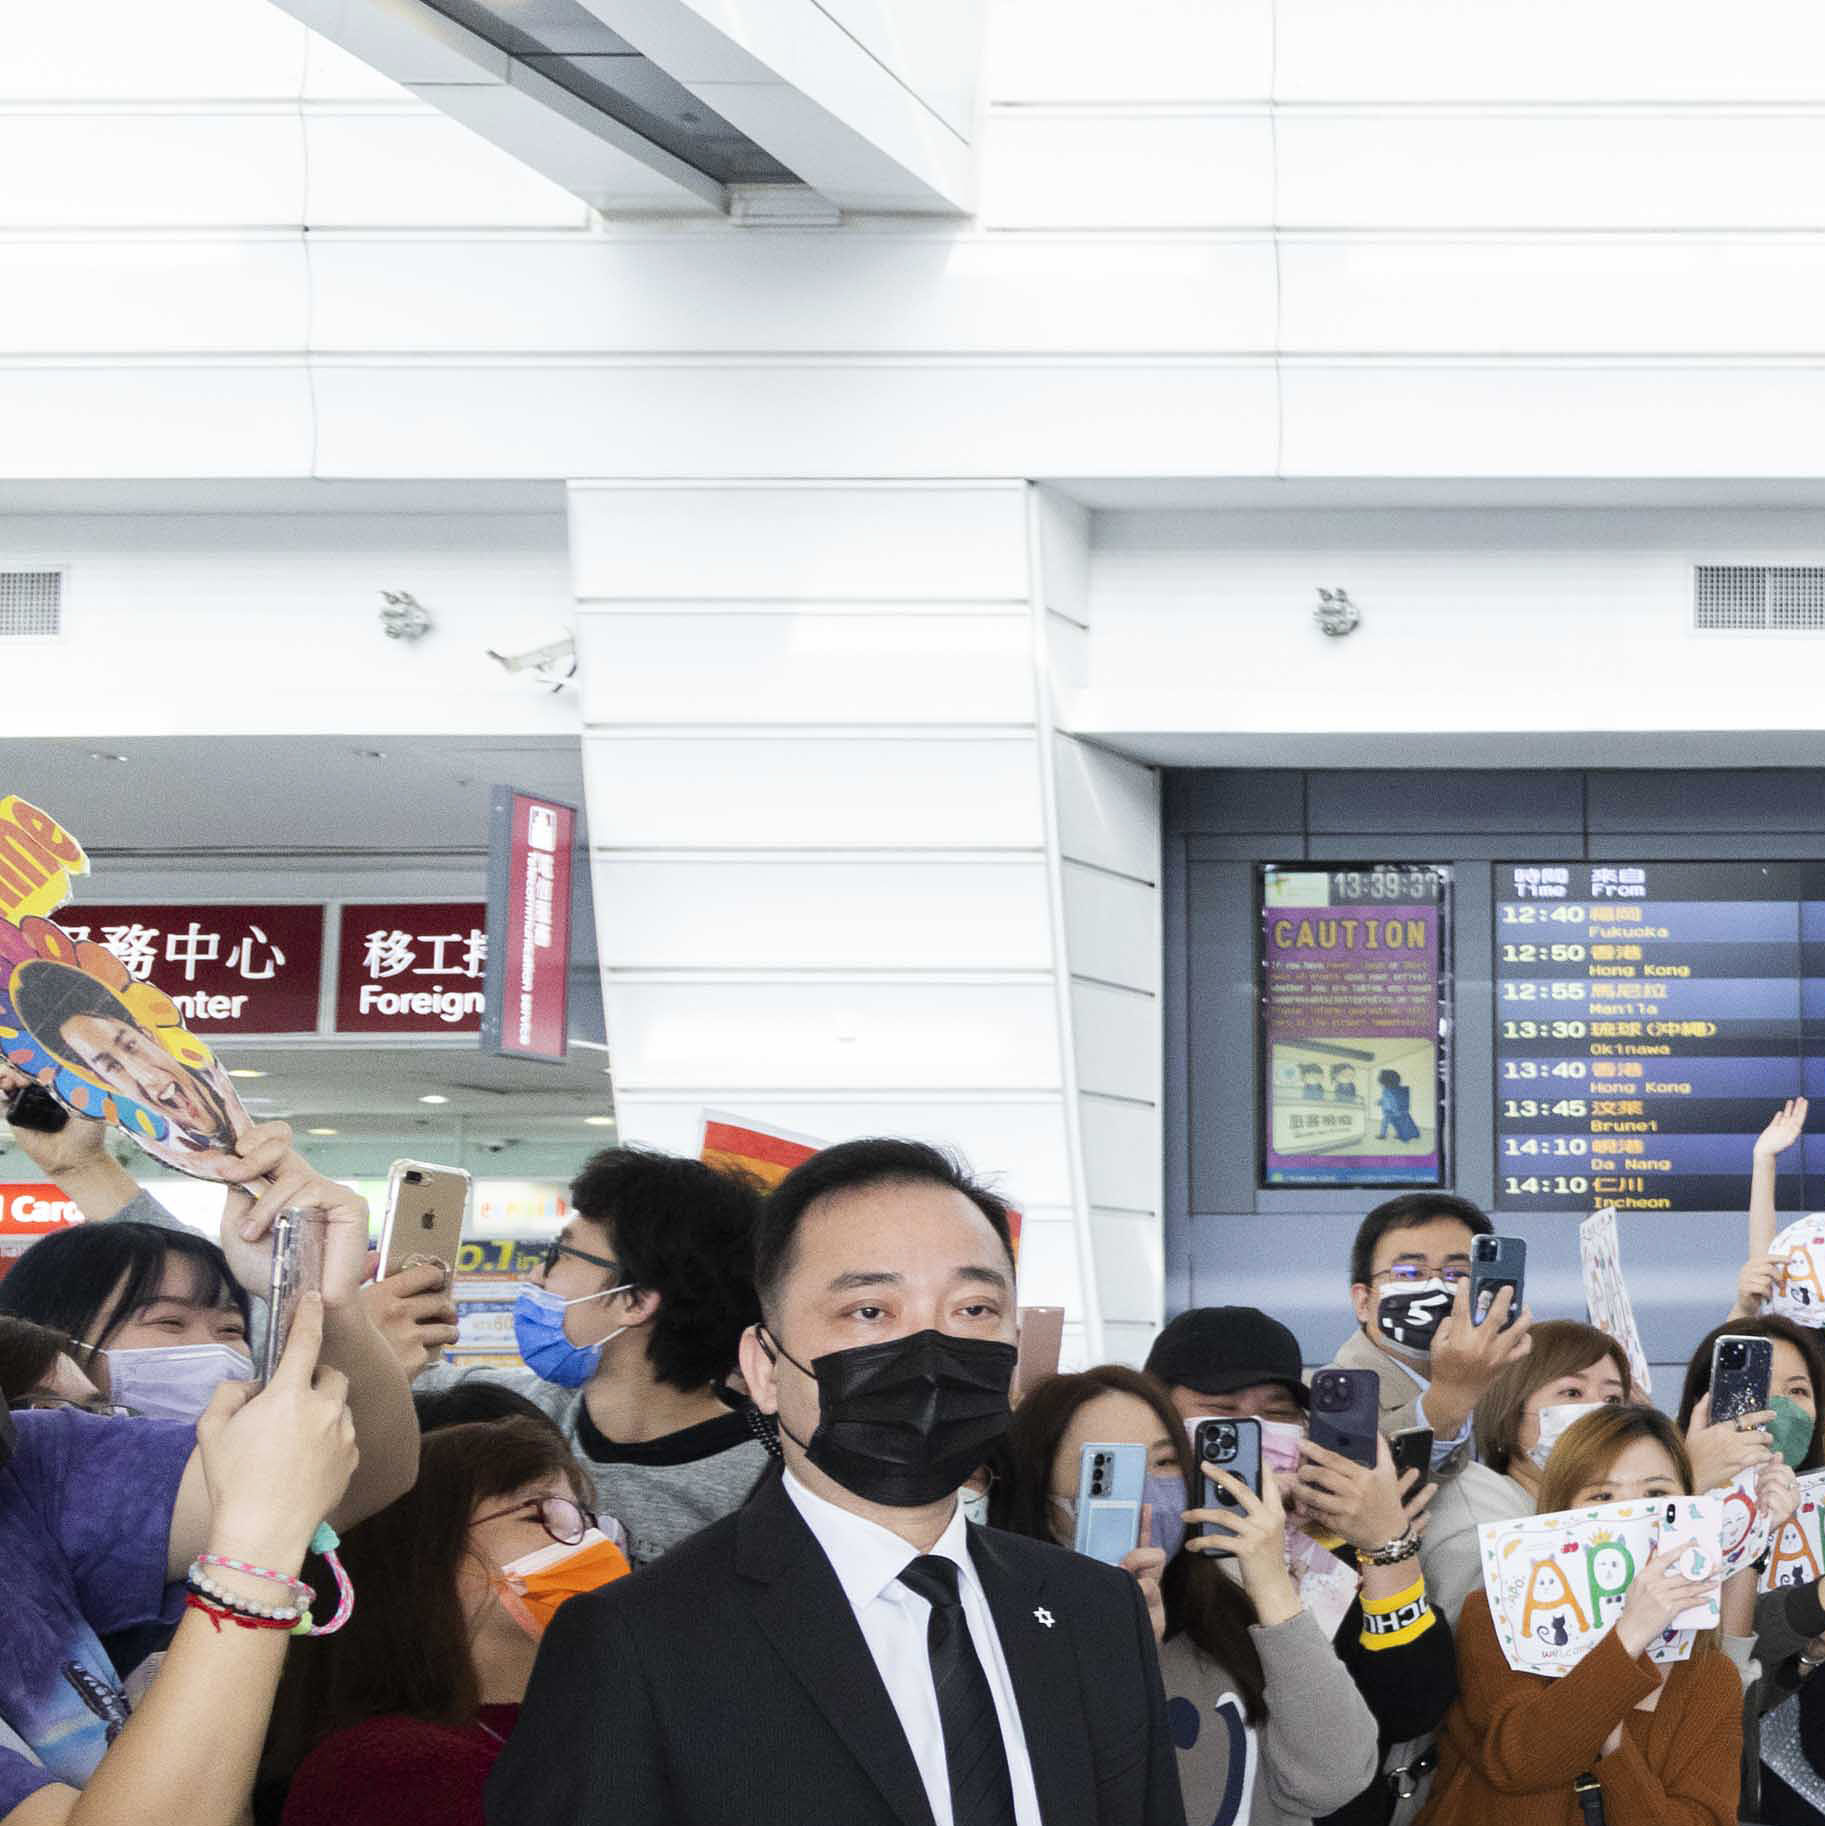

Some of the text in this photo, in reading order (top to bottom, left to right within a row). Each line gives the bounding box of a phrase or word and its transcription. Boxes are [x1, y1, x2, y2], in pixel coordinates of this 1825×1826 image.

[1514, 884, 1566, 896] Time
[1592, 884, 1646, 896] From
[1503, 906, 1583, 923] 12:40
[1274, 919, 1426, 949] CAUTION
[1589, 926, 1668, 938] Fukuoka
[1503, 945, 1584, 961] 12:50
[1589, 965, 1690, 977] Hong Kong
[1503, 984, 1584, 999] 12:55
[359, 984, 486, 1023] Foreign
[1589, 1003, 1658, 1015] Manila
[1503, 1022, 1586, 1038] 13:30
[1591, 1043, 1670, 1054] Okinawa
[1504, 1063, 1586, 1078] 13:40
[1591, 1081, 1691, 1094] Hong Kong
[1504, 1101, 1586, 1117] 13:45
[1591, 1120, 1658, 1132] Brunei
[1504, 1139, 1586, 1155] 14:10
[1625, 1159, 1671, 1171] Nang
[1505, 1178, 1587, 1194] 14:10
[1594, 1178, 1643, 1192] 仁川
[1593, 1197, 1670, 1208] Incheon
